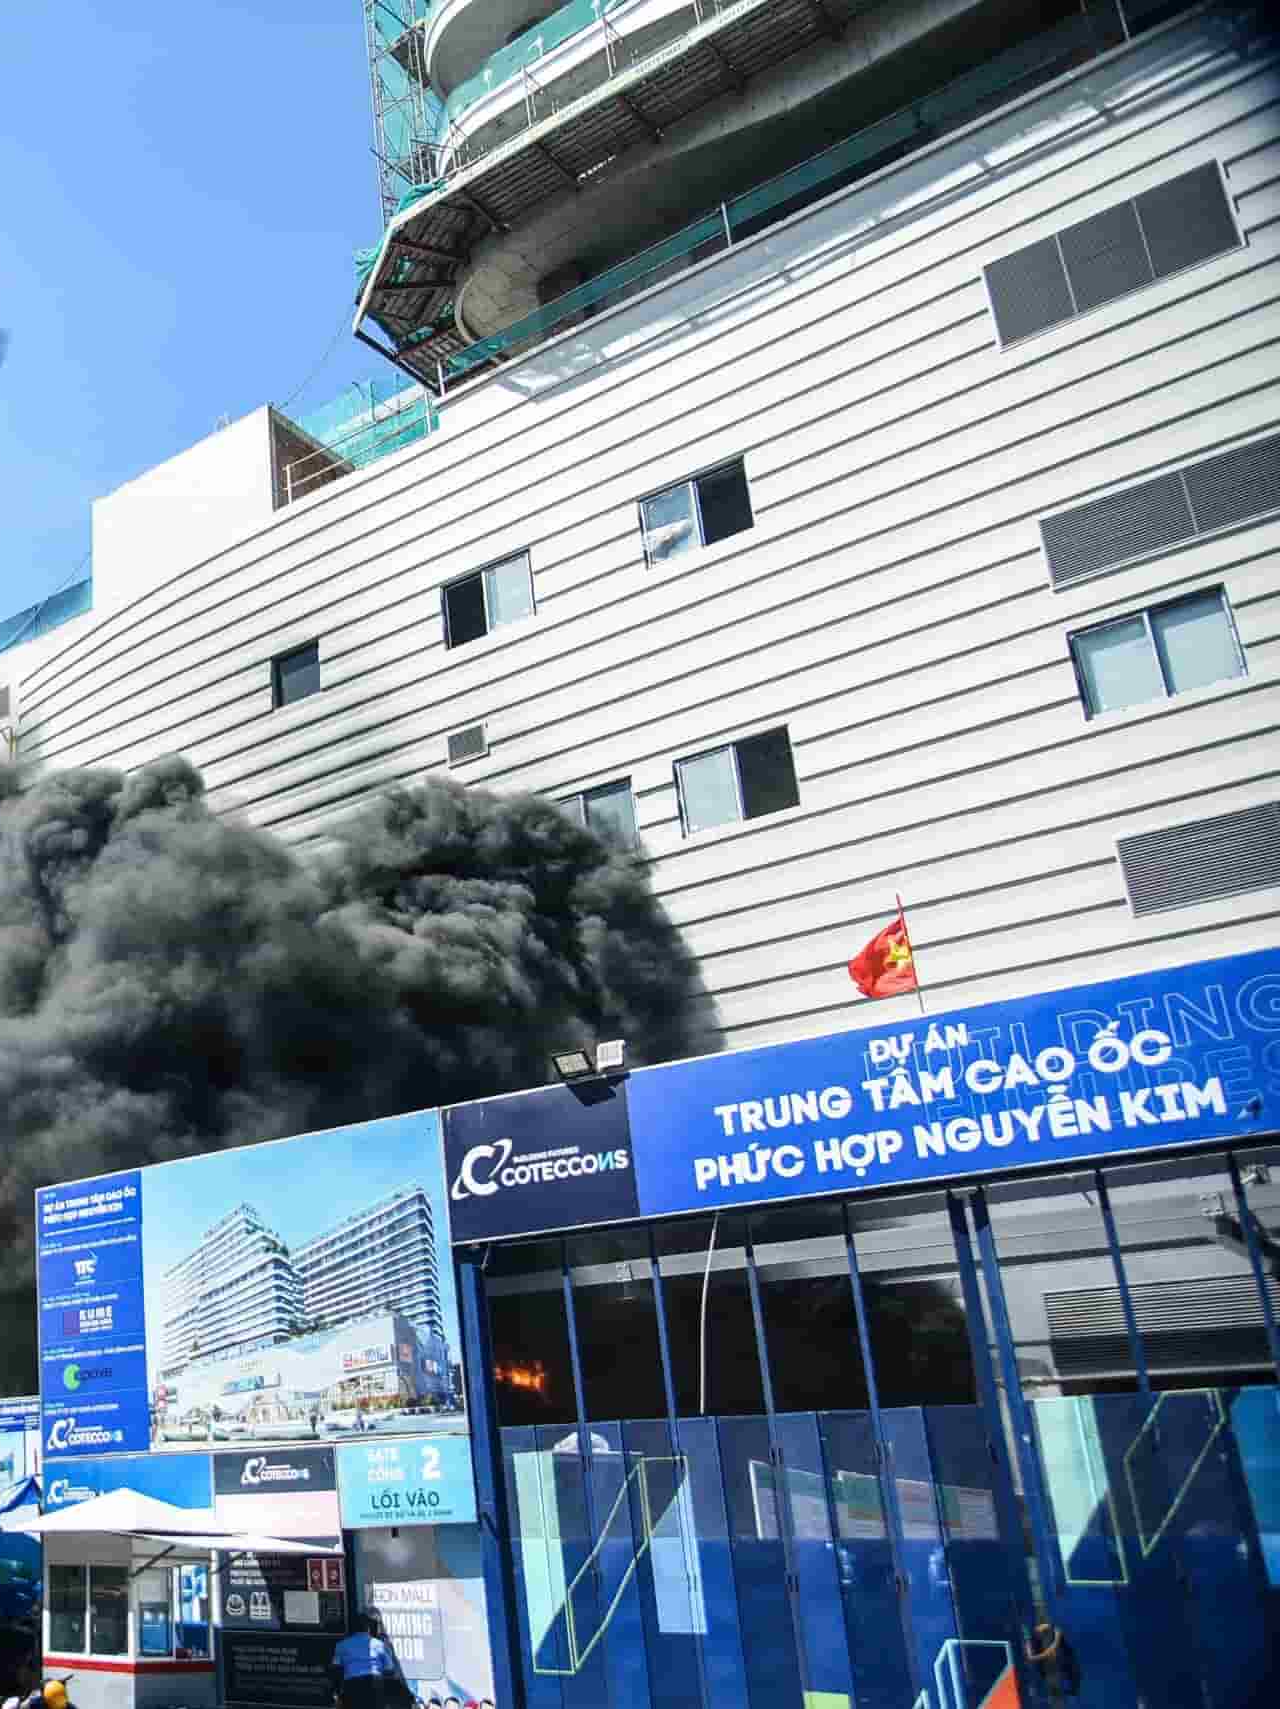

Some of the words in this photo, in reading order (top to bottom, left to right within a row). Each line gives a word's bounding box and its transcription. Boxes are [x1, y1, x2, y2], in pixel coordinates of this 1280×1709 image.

[868, 1032, 915, 1066] DỰ
[923, 1022, 969, 1055] ÁN
[713, 1086, 853, 1137] TRUNG
[861, 1066, 956, 1112] TÂM
[964, 1046, 1075, 1094] CAO
[1087, 1019, 1173, 1073] ỐC
[693, 1142, 805, 1192] PHỨC
[813, 1129, 903, 1177] HỢP
[913, 1083, 1112, 1159] NGUYỄN
[1121, 1076, 1228, 1128] KIM
[421, 1444, 441, 1480] 2
[371, 1488, 400, 1510] LỐI
[405, 1487, 441, 1508] VÀO
[381, 1612, 432, 1635] OMING
[393, 1638, 424, 1660] OON
